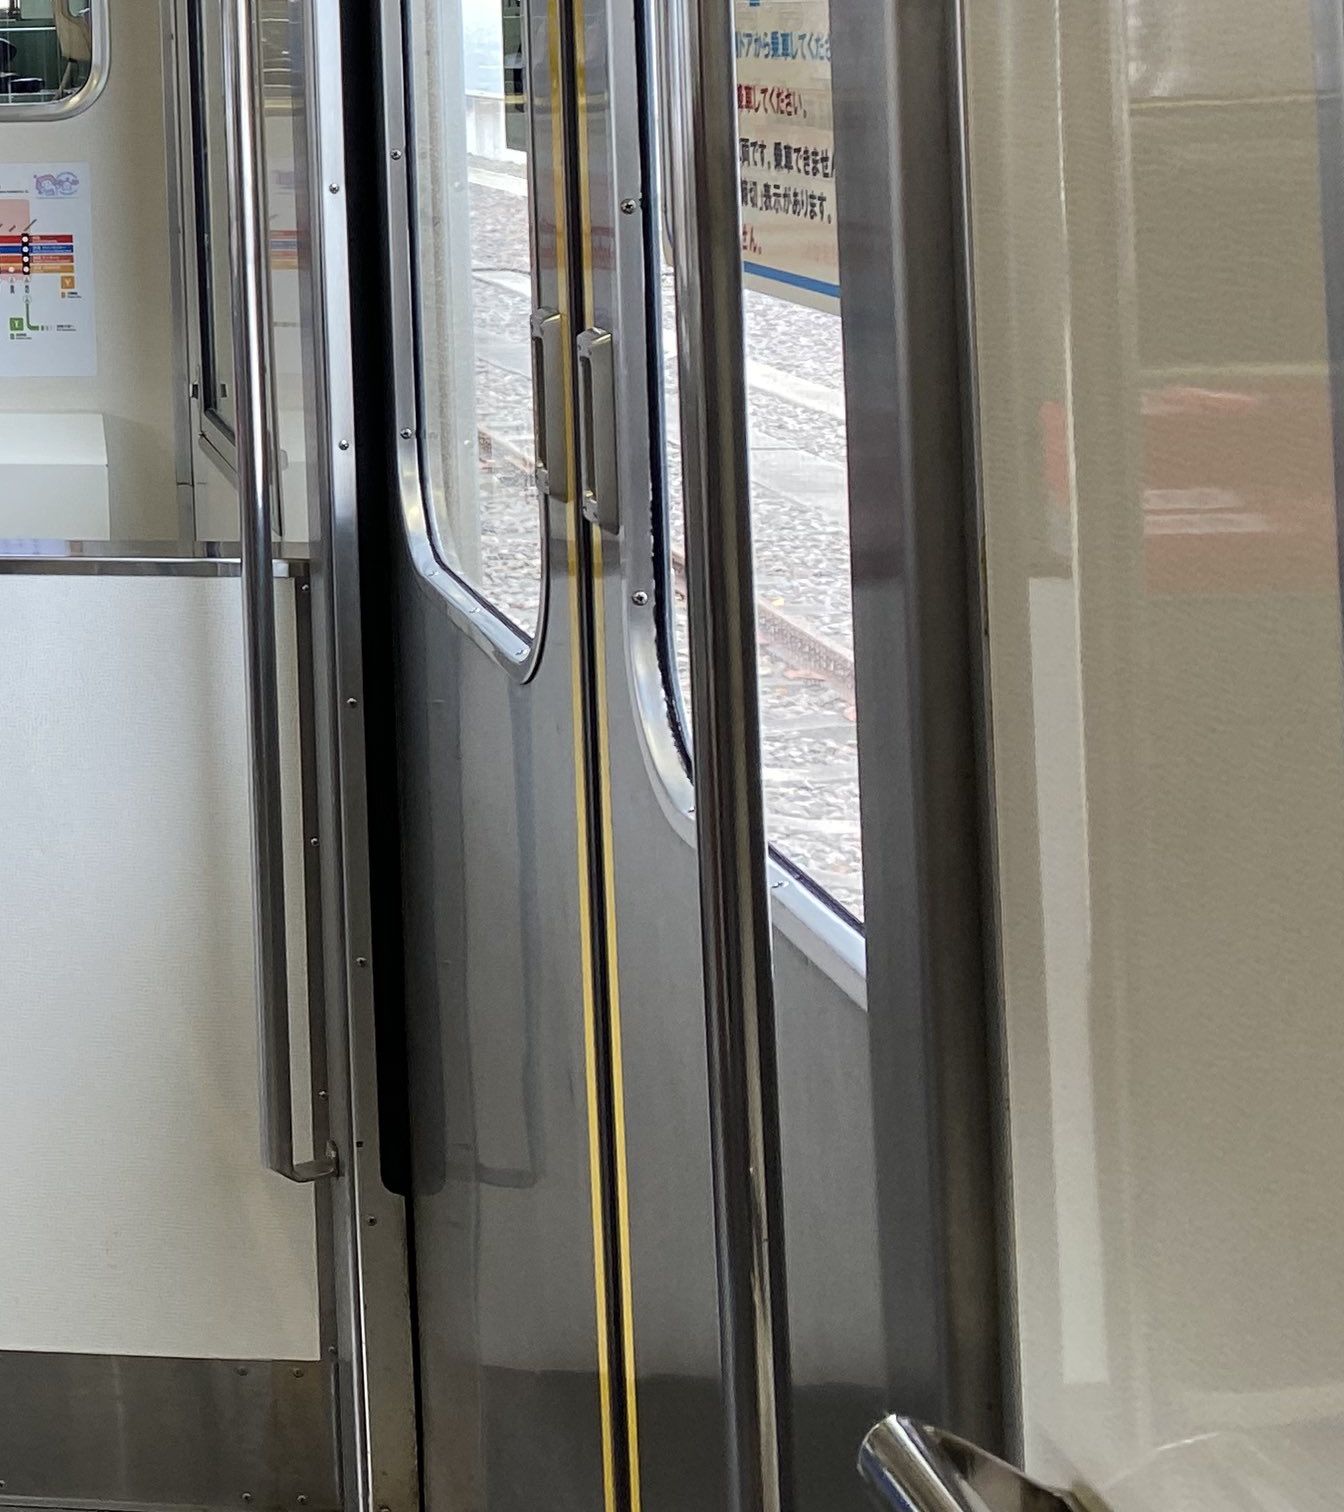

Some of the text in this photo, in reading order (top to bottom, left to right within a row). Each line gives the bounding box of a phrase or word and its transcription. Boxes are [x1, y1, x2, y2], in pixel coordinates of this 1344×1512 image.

[739, 137, 834, 178] 両です。乗車できませ
